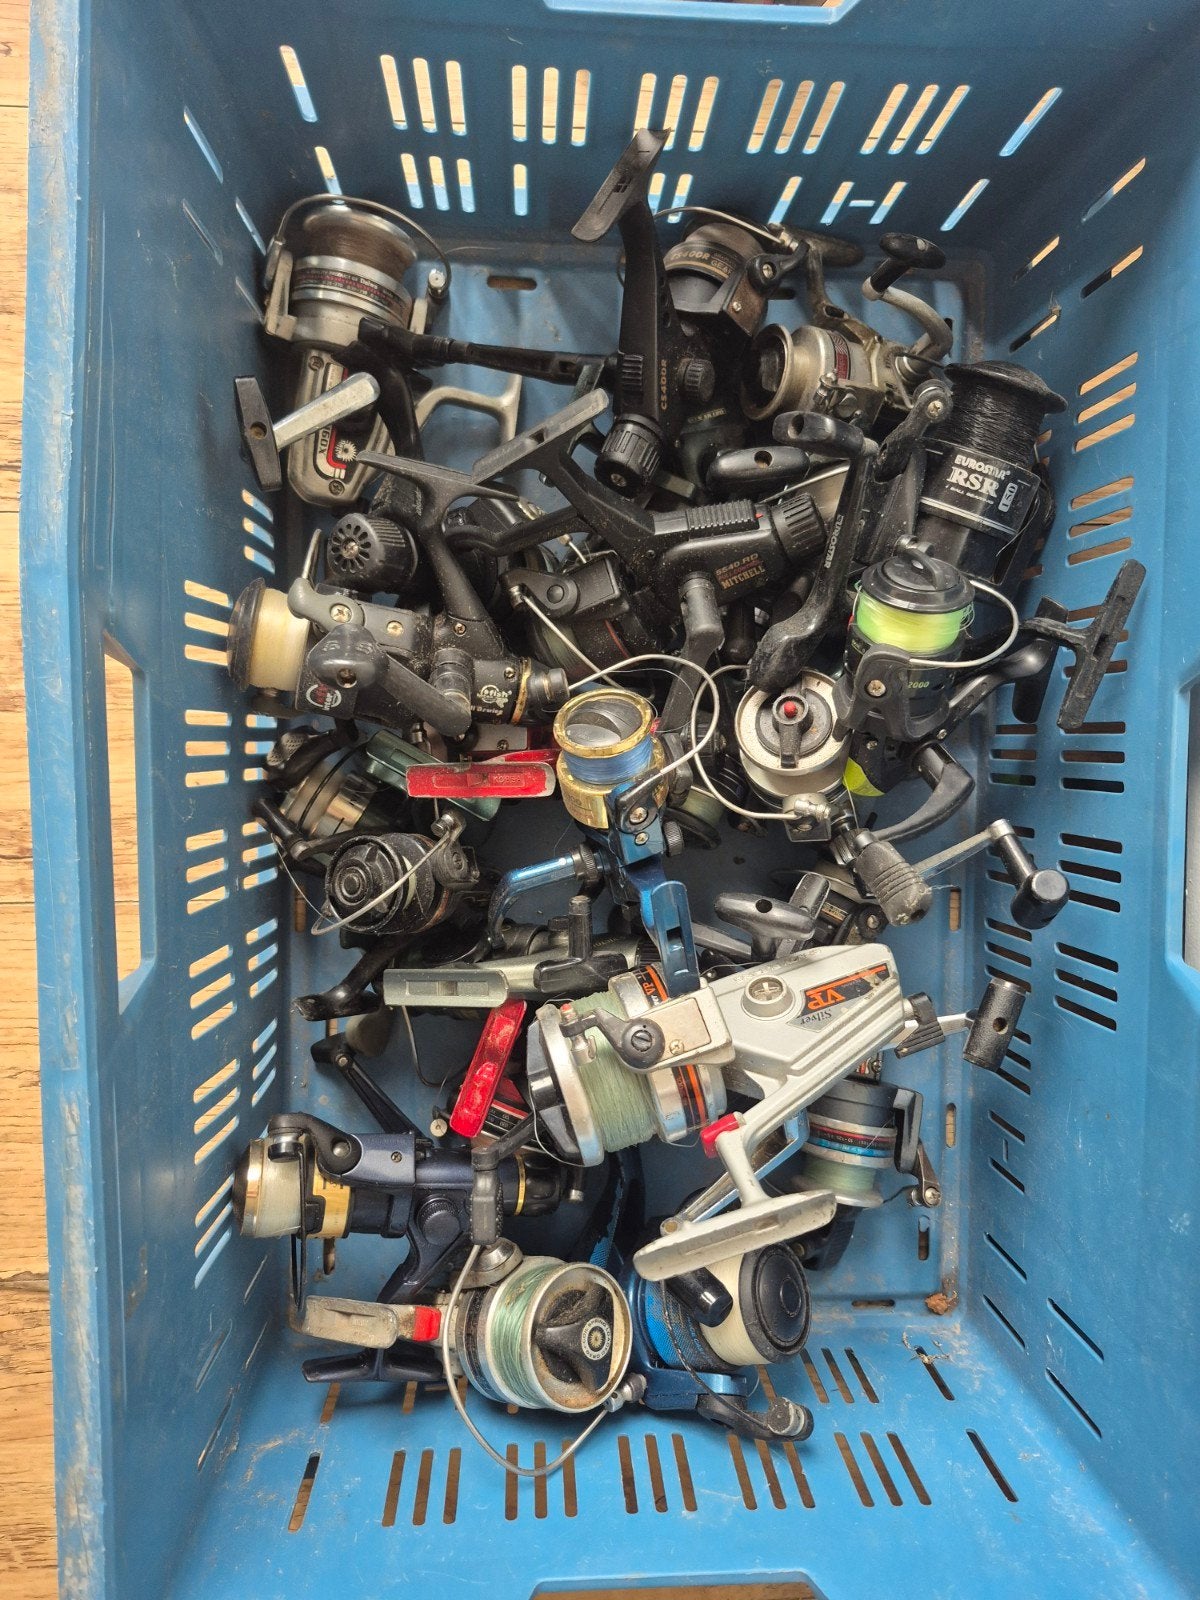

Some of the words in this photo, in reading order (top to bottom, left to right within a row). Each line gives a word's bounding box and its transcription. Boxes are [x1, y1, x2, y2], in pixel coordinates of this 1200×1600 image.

[360, 278, 379, 290] Daiwa
[660, 359, 668, 410] CS400R
[946, 466, 1000, 498] RSR
[825, 514, 844, 569] EUROSTAR
[720, 565, 765, 590] MITCHELL
[807, 988, 846, 1011] VP
[800, 1009, 832, 1025] Silver
